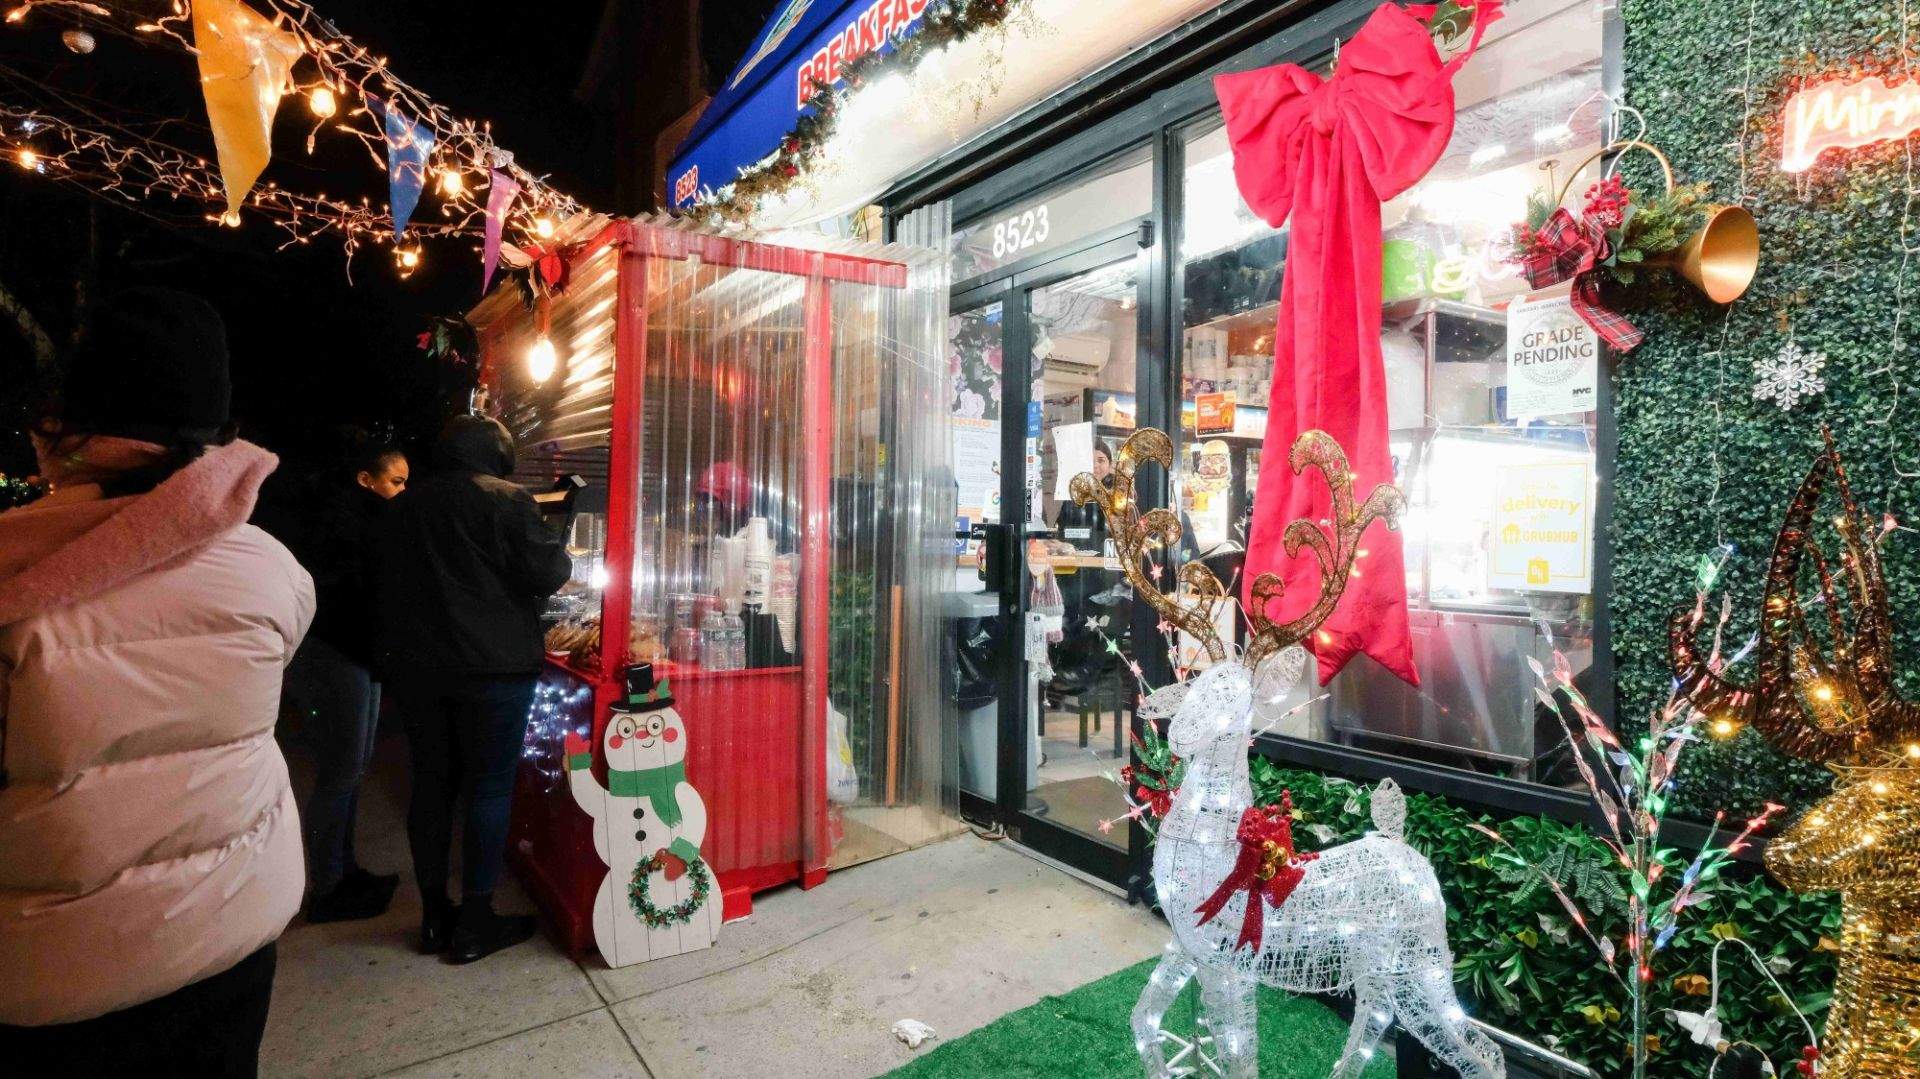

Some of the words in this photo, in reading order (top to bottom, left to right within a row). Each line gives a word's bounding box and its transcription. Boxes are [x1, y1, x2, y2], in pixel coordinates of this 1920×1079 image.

[992, 205, 1049, 258] 8523
[1522, 325, 1583, 349] GRADE
[1513, 342, 1593, 366] PENDING
[1503, 494, 1581, 515] delivery
[1523, 531, 1578, 543] GRUBHUB
